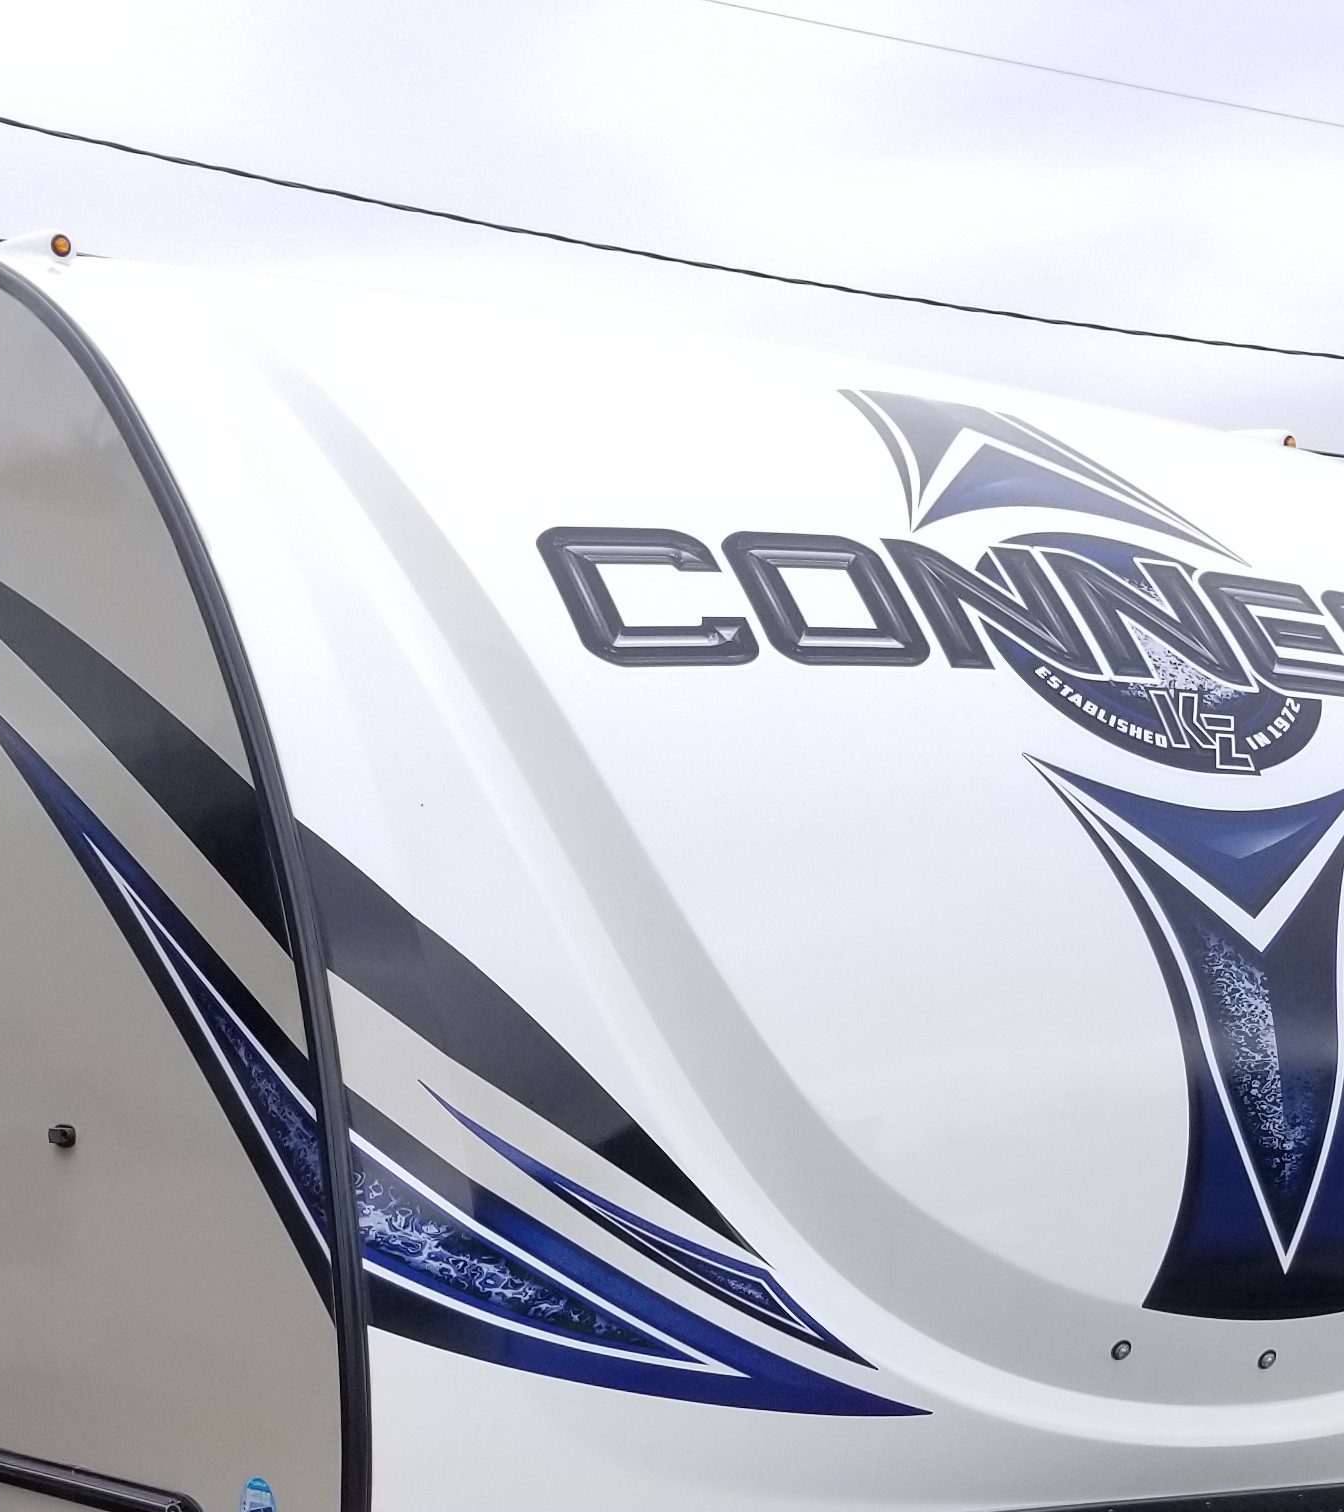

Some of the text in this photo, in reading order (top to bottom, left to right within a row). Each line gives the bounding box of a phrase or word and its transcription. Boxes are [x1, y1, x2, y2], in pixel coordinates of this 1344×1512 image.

[1034, 666, 1301, 750] ESTABLISHED IN 1972
